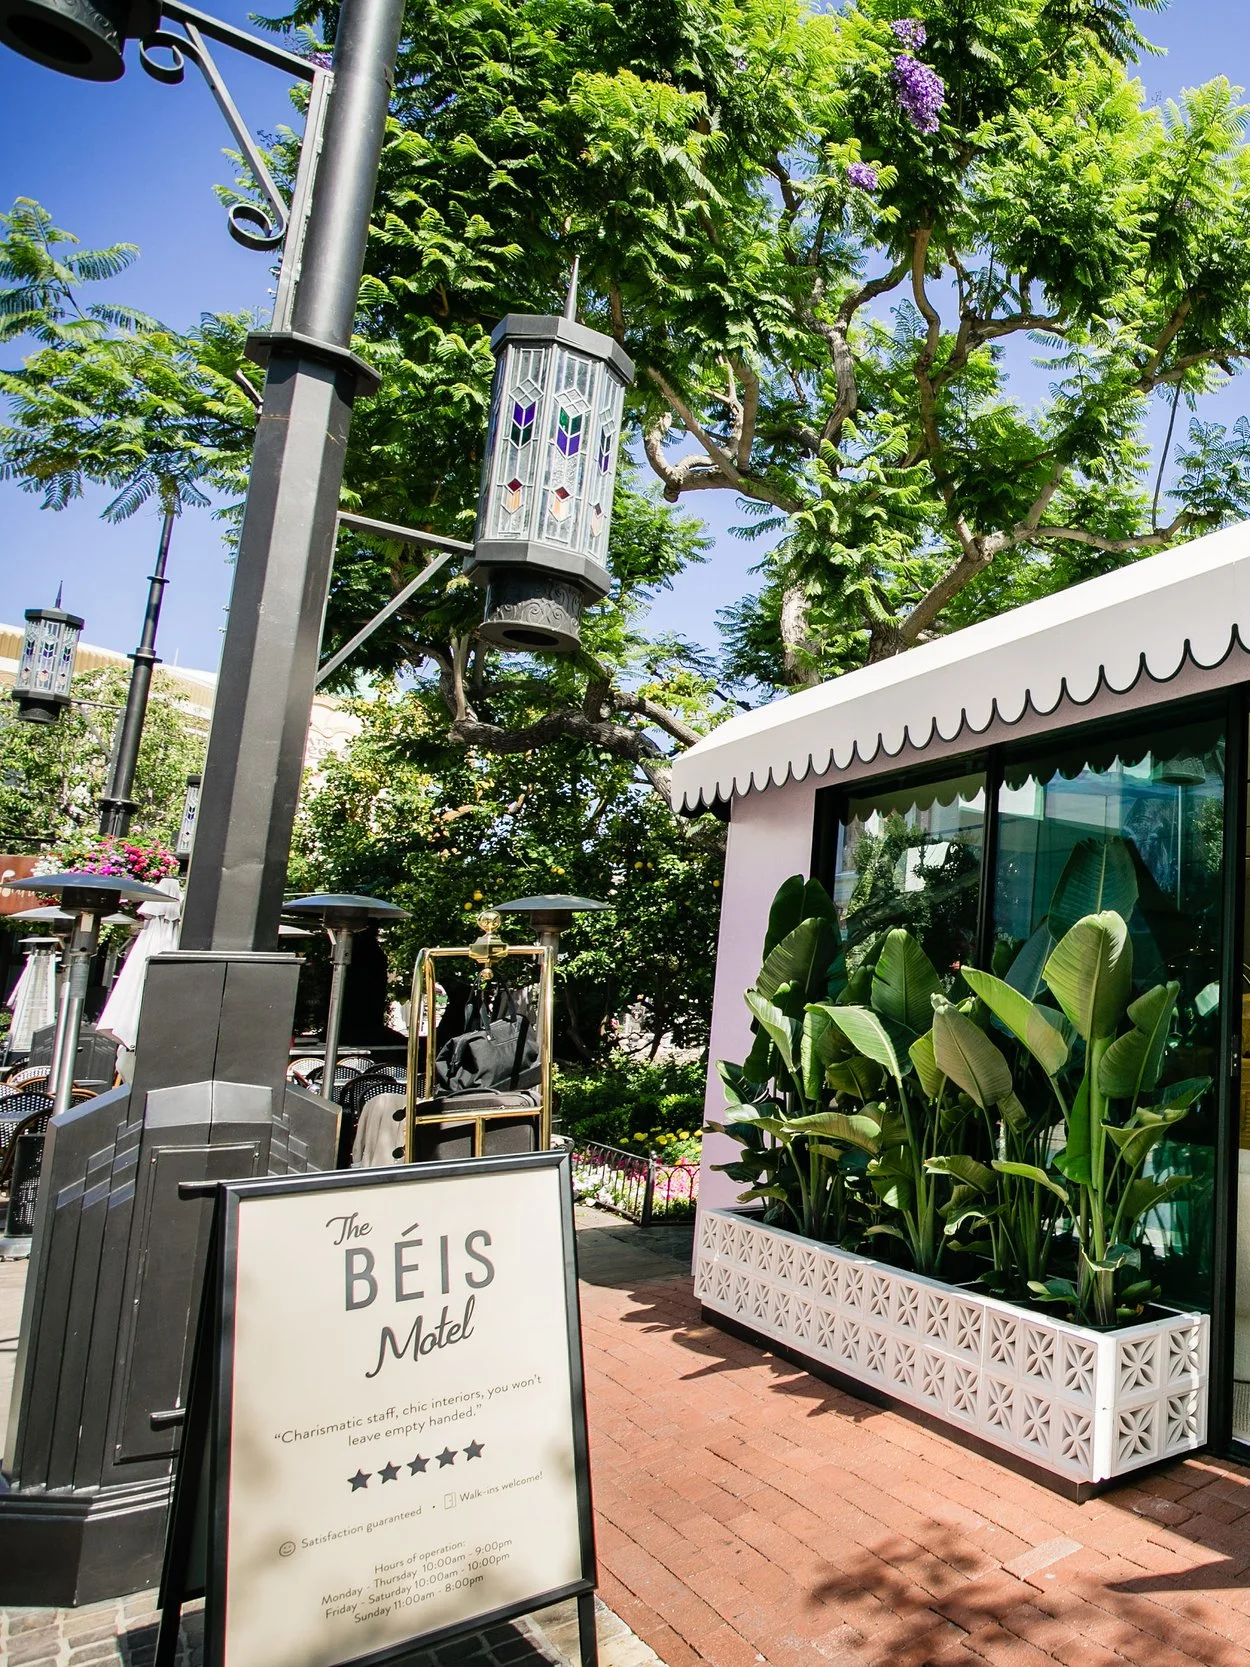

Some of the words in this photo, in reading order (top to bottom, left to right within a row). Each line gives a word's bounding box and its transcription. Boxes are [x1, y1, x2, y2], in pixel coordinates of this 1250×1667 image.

[326, 1212, 373, 1246] The
[345, 1222, 495, 1311] BÉIS
[365, 1294, 476, 1379] Motel
[367, 1406, 399, 1424] staff,
[402, 1401, 428, 1416] chic
[431, 1391, 484, 1409] interiors,
[487, 1384, 509, 1399] you
[348, 1432, 381, 1447] leave
[385, 1421, 426, 1437] empty
[459, 1486, 500, 1502] Walk-ins
[501, 1471, 543, 1491] welcome!
[301, 1524, 364, 1549] Satisfaction
[366, 1505, 422, 1533] guaranteed
[321, 1587, 363, 1606] Monday
[374, 1570, 418, 1588] Thursday
[422, 1554, 466, 1573] 10:00am
[475, 1538, 513, 1557] 9:00pm
[374, 1560, 405, 1574] Hours
[406, 1552, 418, 1565] of
[419, 1540, 466, 1562] operation:
[326, 1603, 358, 1619] Friday
[368, 1585, 412, 1604] Saturday
[415, 1570, 458, 1589] 10:00am
[468, 1553, 510, 1572] 10:00pm
[354, 1606, 391, 1623] Sunday
[393, 1591, 435, 1610] 11:00am
[445, 1575, 484, 1593] 8:00pm
